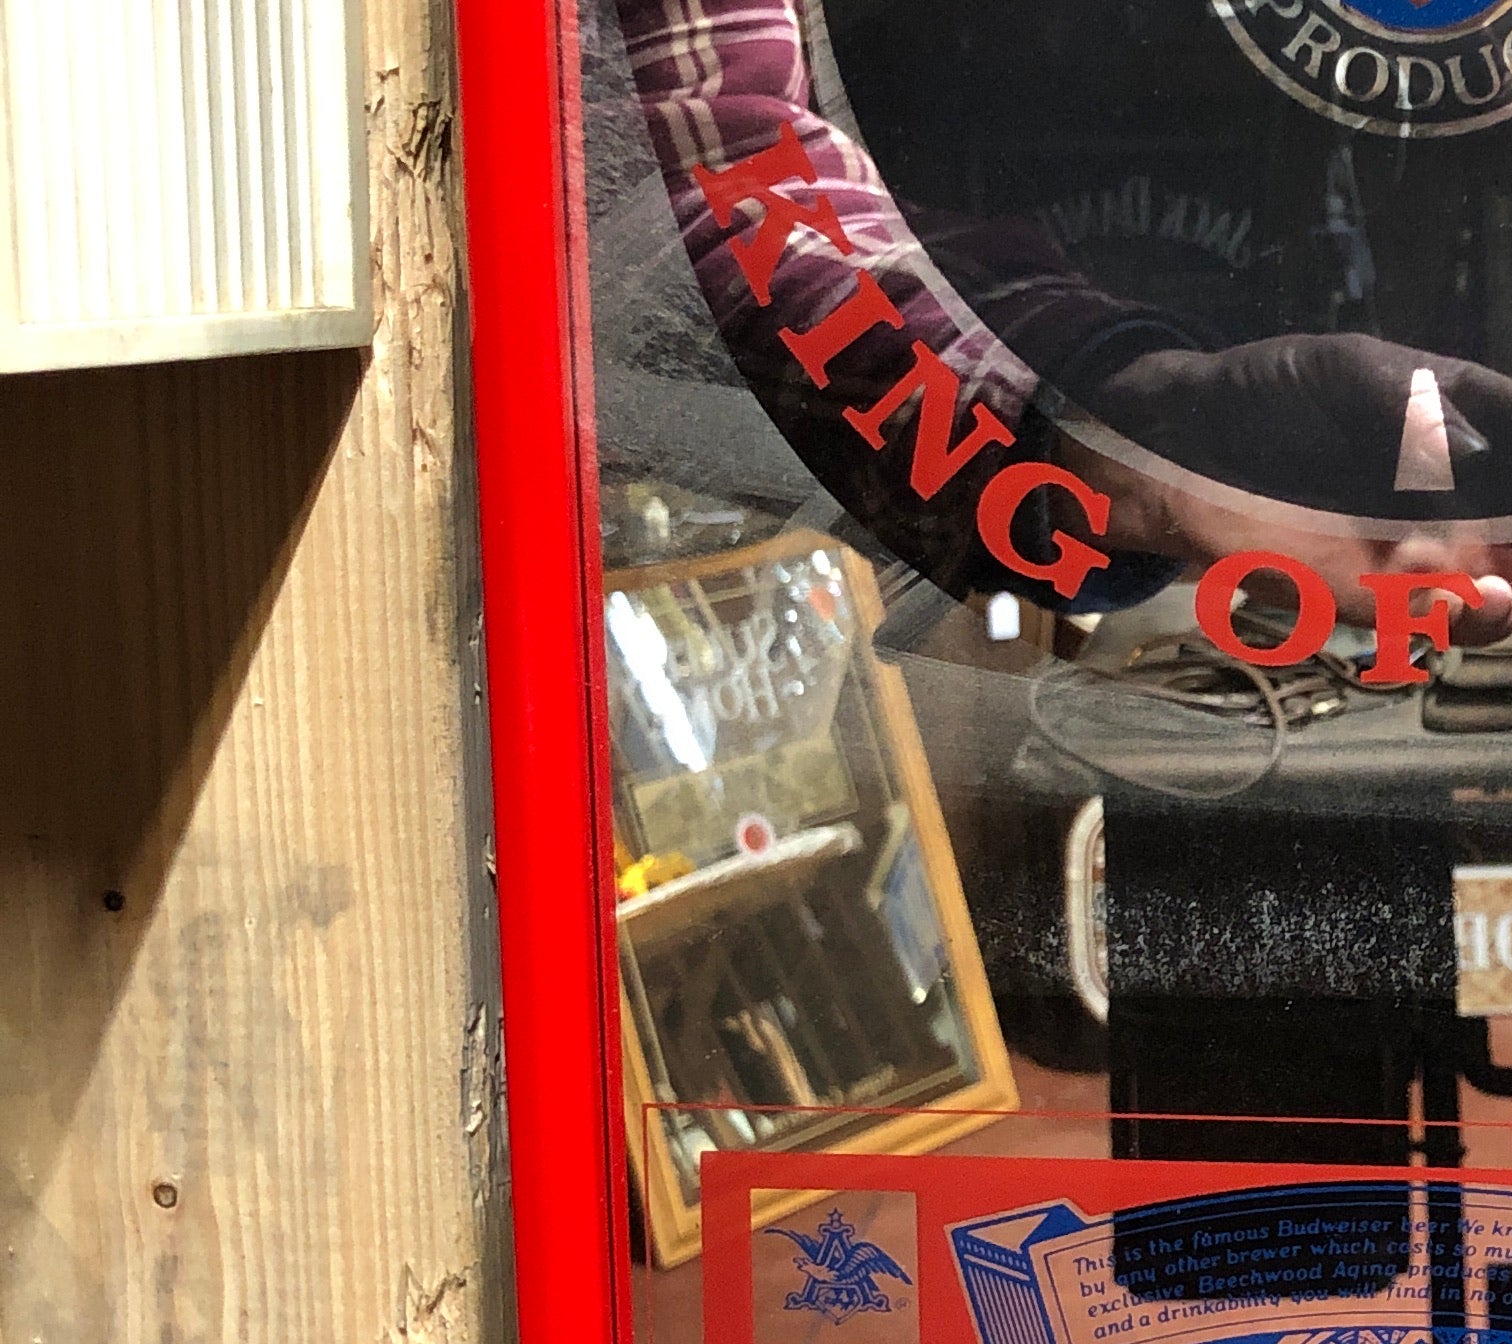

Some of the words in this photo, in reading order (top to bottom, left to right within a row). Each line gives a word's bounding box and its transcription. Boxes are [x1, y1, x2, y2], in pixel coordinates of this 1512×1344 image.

[693, 120, 1112, 600] KING
[1195, 550, 1485, 686] OF
[1073, 1255, 1116, 1276] This
[1125, 1246, 1142, 1262] is
[1149, 1236, 1184, 1255] the
[1192, 1223, 1270, 1253] famous
[1277, 1218, 1392, 1237] Budweiser
[1457, 1217, 1485, 1234] We
[1079, 1280, 1106, 1298] by
[1116, 1268, 1156, 1289] any
[1165, 1255, 1221, 1277] other
[1226, 1243, 1303, 1265] brewer
[1309, 1239, 1377, 1256] which
[1386, 1239, 1446, 1256] costs
[1452, 1243, 1477, 1257] so
[1087, 1283, 1186, 1318] exclusive
[1198, 1264, 1323, 1293] Beechwood
[1332, 1261, 1400, 1281] Aging
[1406, 1262, 1511, 1283] produces
[1094, 1315, 1134, 1340] and
[1140, 1315, 1151, 1327] a
[1157, 1294, 1281, 1324] drinkability
[1291, 1286, 1330, 1305] you
[1337, 1282, 1377, 1299] will
[1386, 1282, 1431, 1302] find
[1439, 1284, 1462, 1301] in
[1469, 1289, 1496, 1304] no
